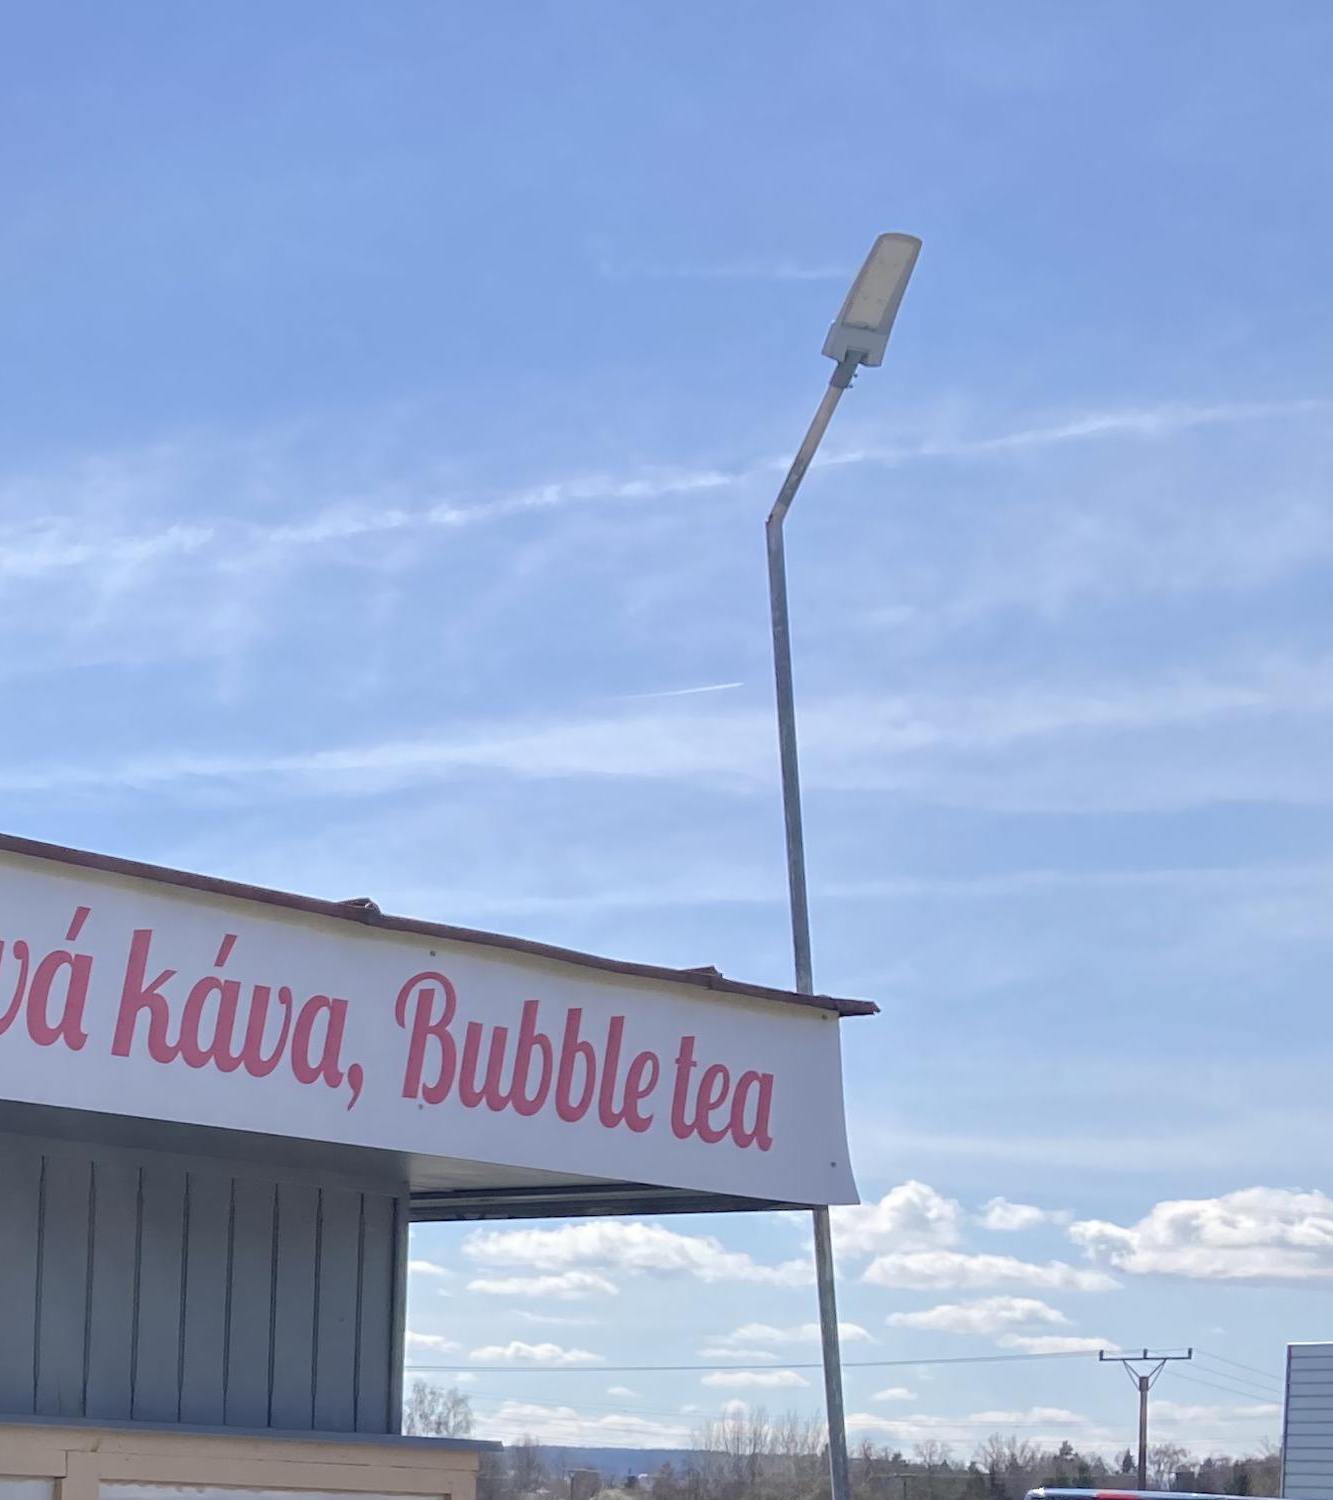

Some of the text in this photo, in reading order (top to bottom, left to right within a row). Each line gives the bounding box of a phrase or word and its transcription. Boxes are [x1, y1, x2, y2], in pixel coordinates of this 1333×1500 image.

[111, 929, 364, 1111] káva,
[395, 971, 660, 1133] Bubble
[670, 1036, 774, 1152] tea
